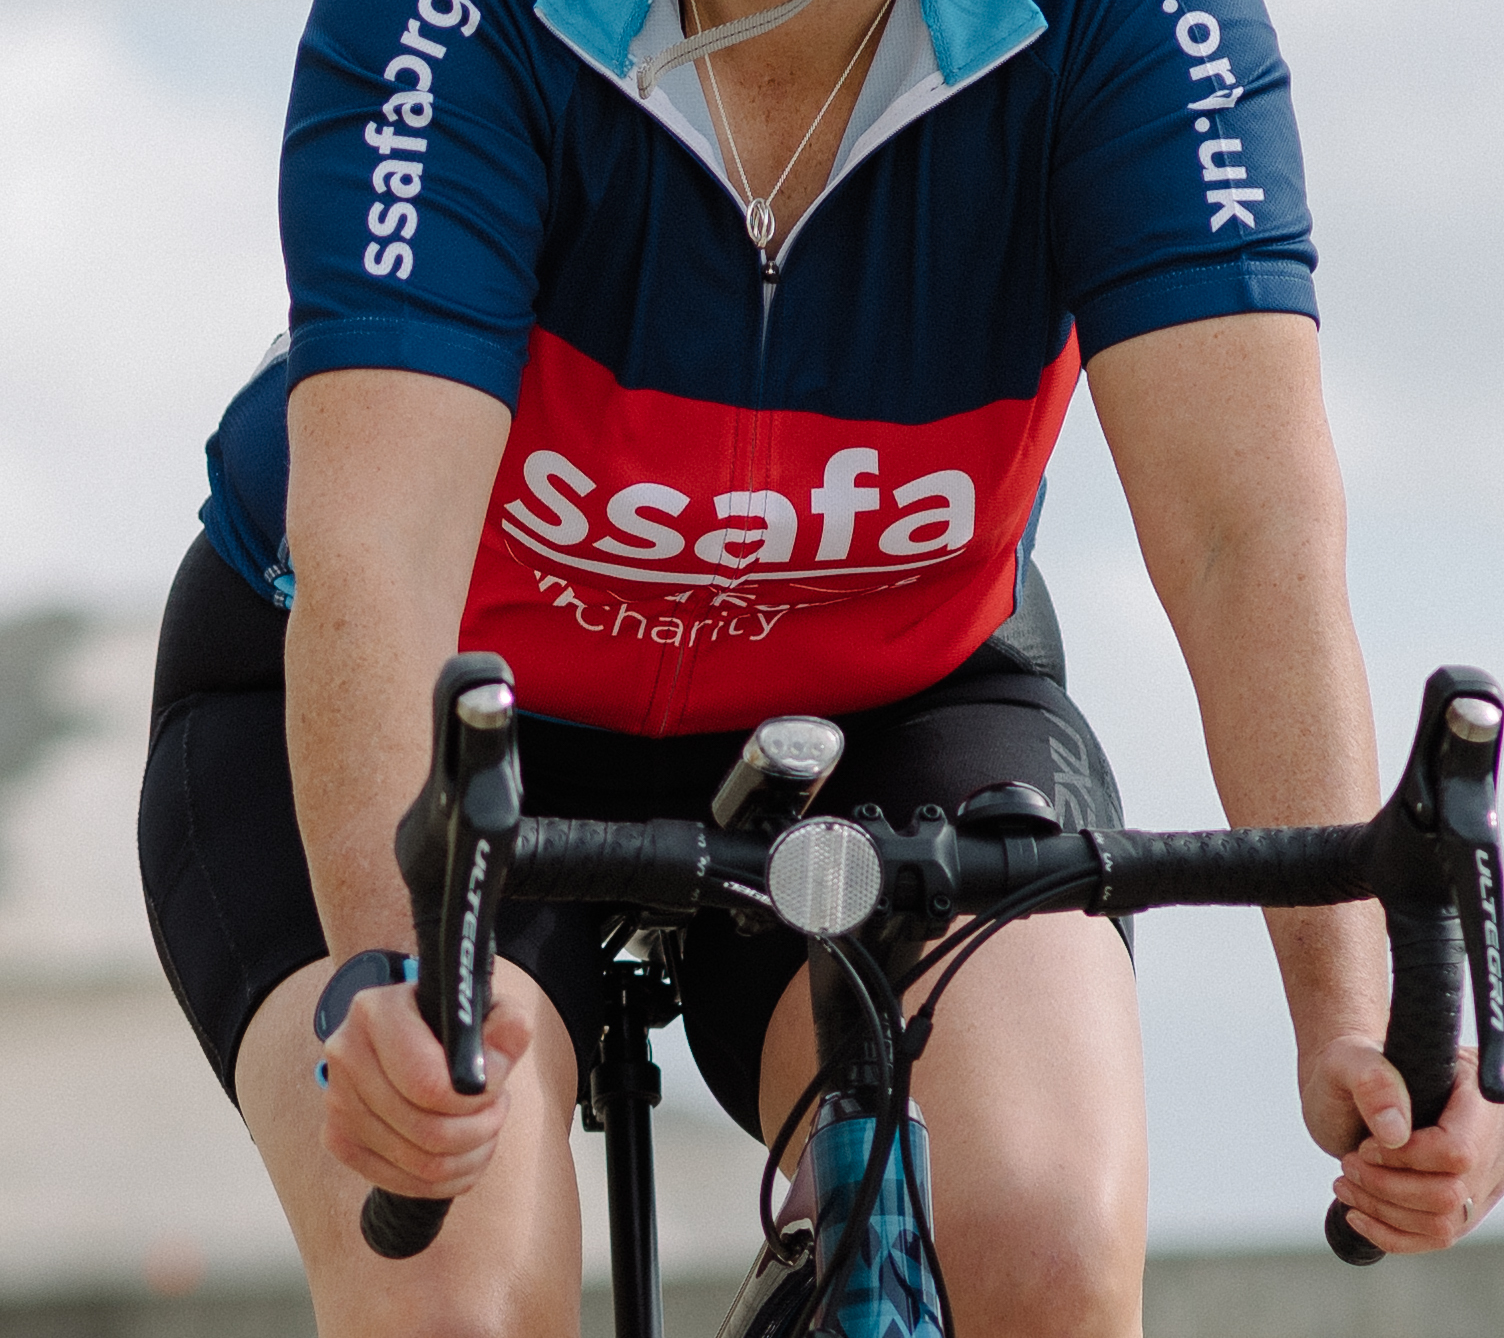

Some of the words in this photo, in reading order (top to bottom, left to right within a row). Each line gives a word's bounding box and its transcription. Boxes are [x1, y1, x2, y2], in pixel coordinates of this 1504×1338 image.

[504, 447, 976, 568] ssafa
[458, 838, 491, 1027] ULTEGRA
[1475, 848, 1504, 1032] ULTEGRA
